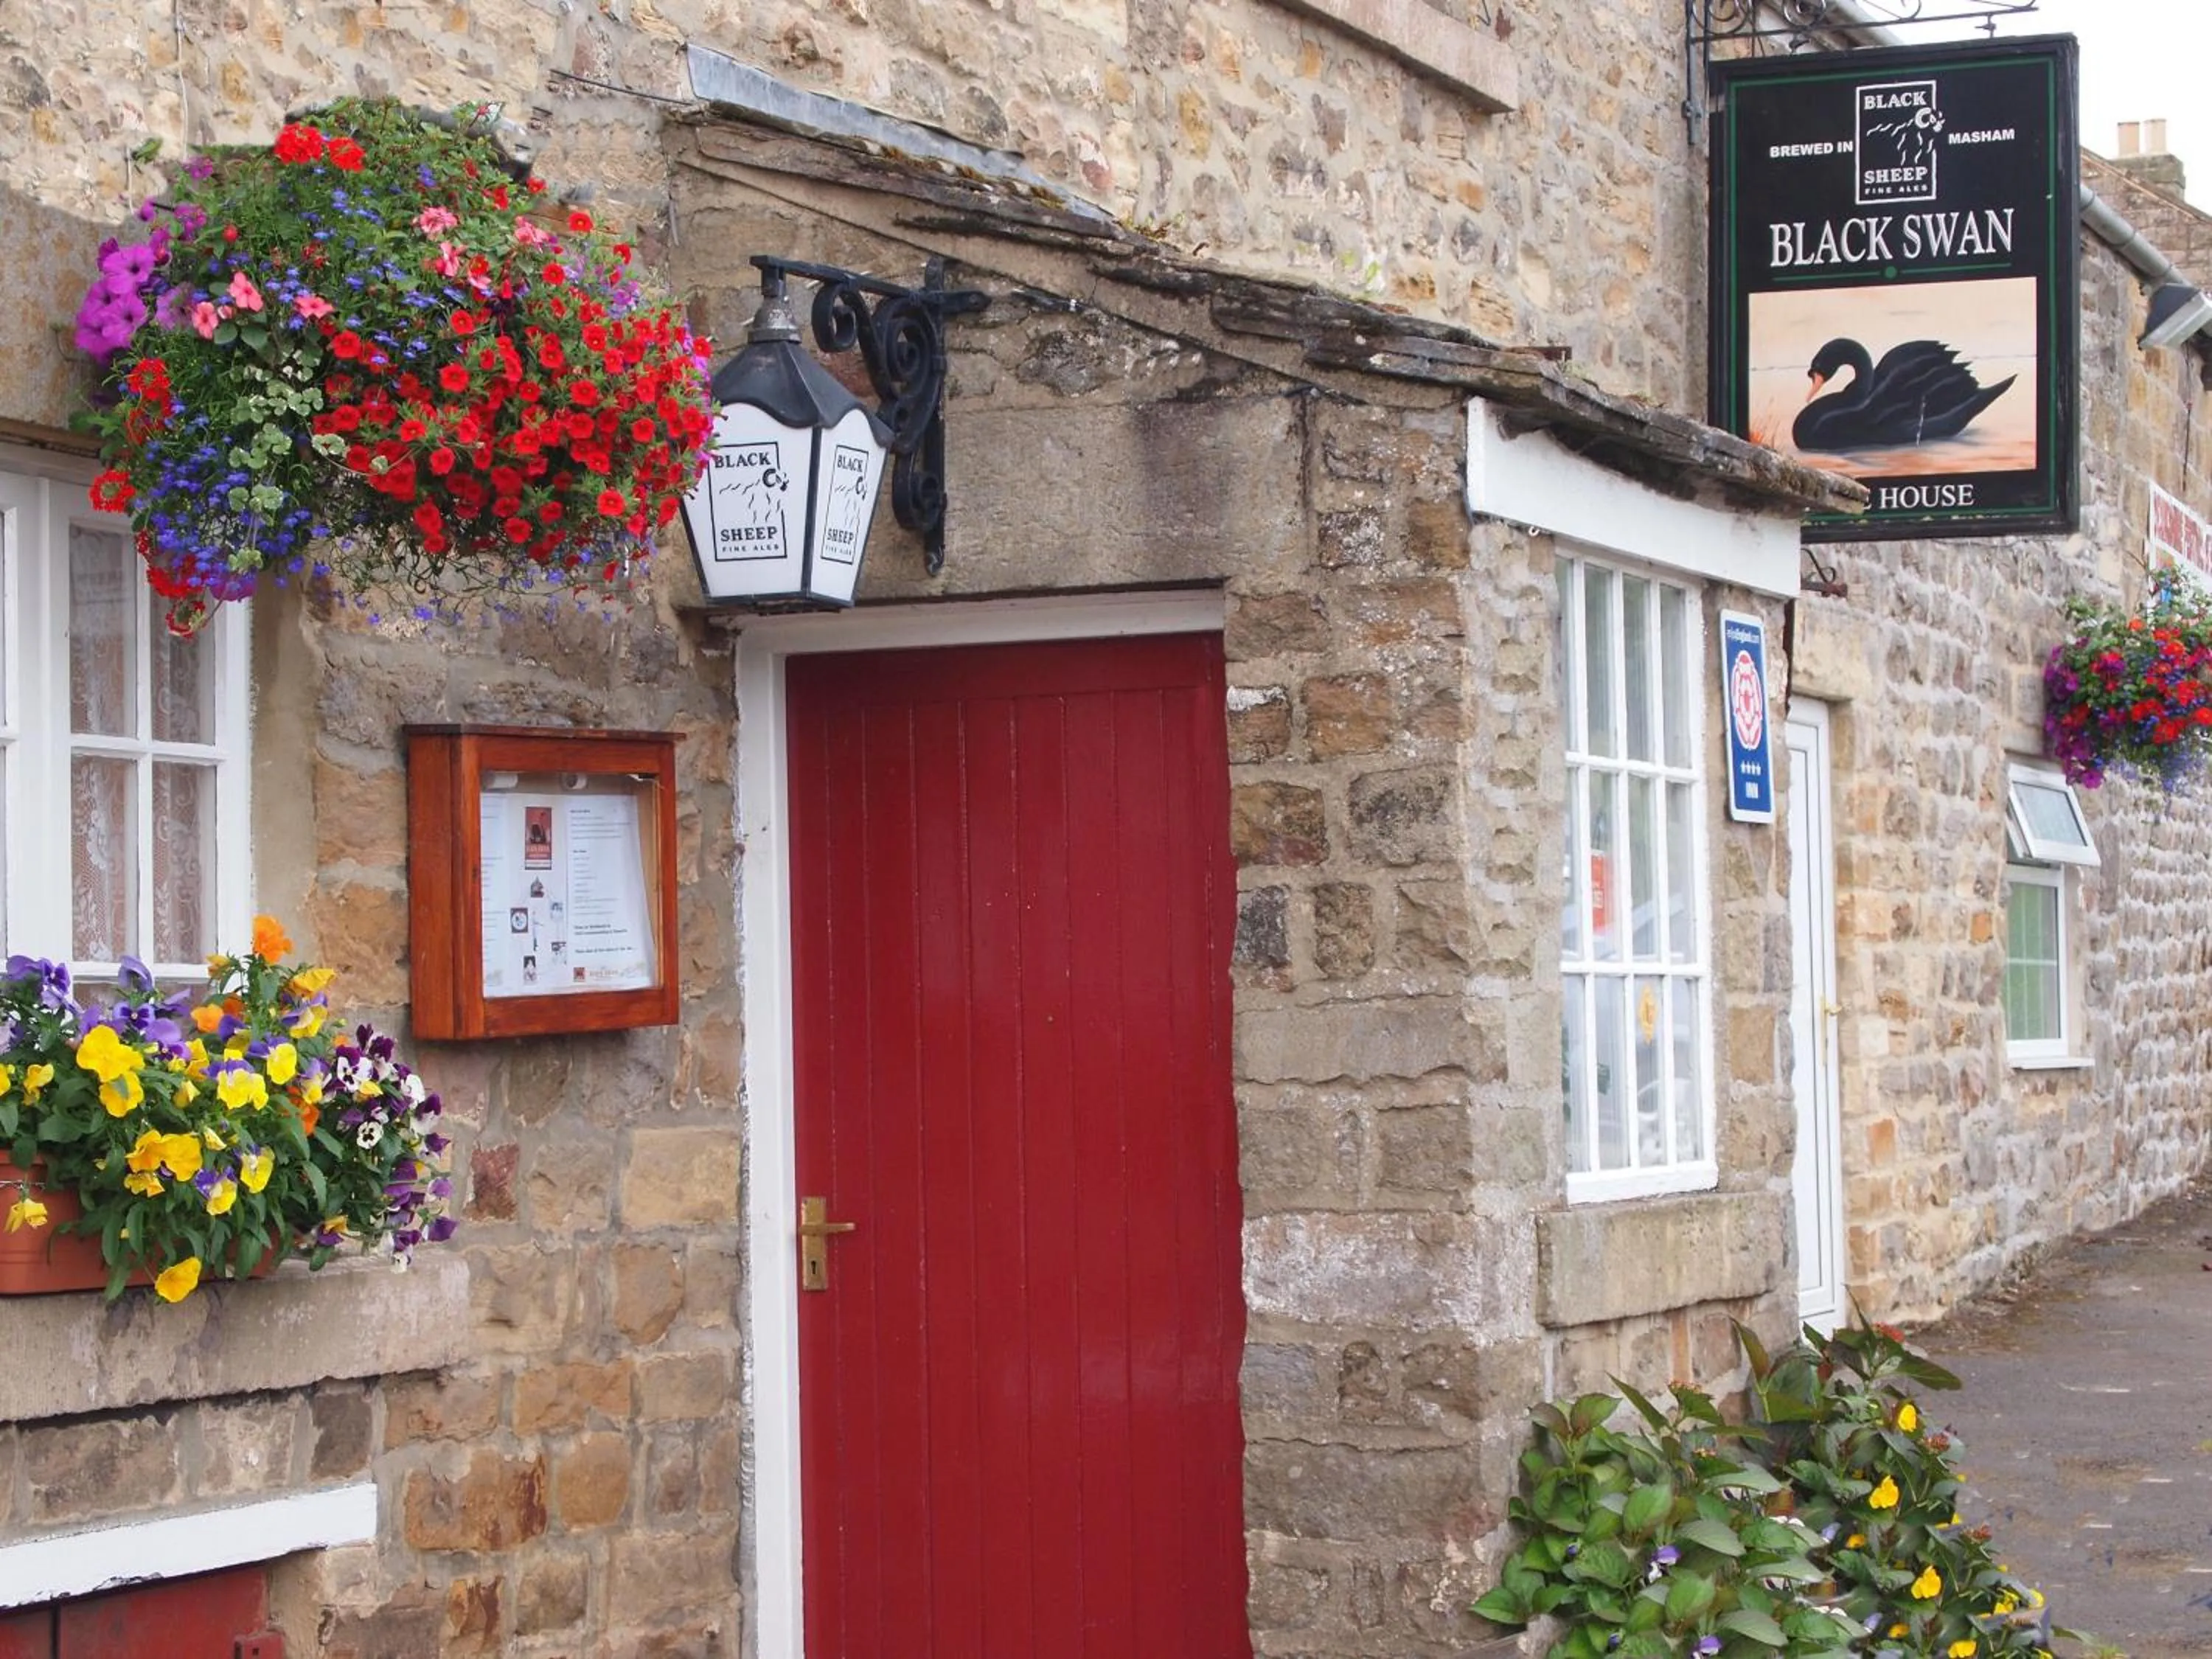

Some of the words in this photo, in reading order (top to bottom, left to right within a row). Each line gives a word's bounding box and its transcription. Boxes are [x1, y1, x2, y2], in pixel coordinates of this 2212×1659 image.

[1864, 91, 1927, 110] BLACK
[1949, 128, 2014, 145] MASHAM
[1770, 142, 1834, 158] BREWED
[1837, 141, 1853, 153] IN
[1864, 166, 1928, 184] SHEEP
[1770, 217, 1893, 267] BLACK
[1903, 208, 2014, 259] SWAN
[714, 452, 771, 468] BLACK
[837, 455, 863, 473] BLACK
[1879, 484, 1975, 509] HOUSE
[720, 526, 778, 542] SHEEP
[827, 528, 854, 544] SHEEP
